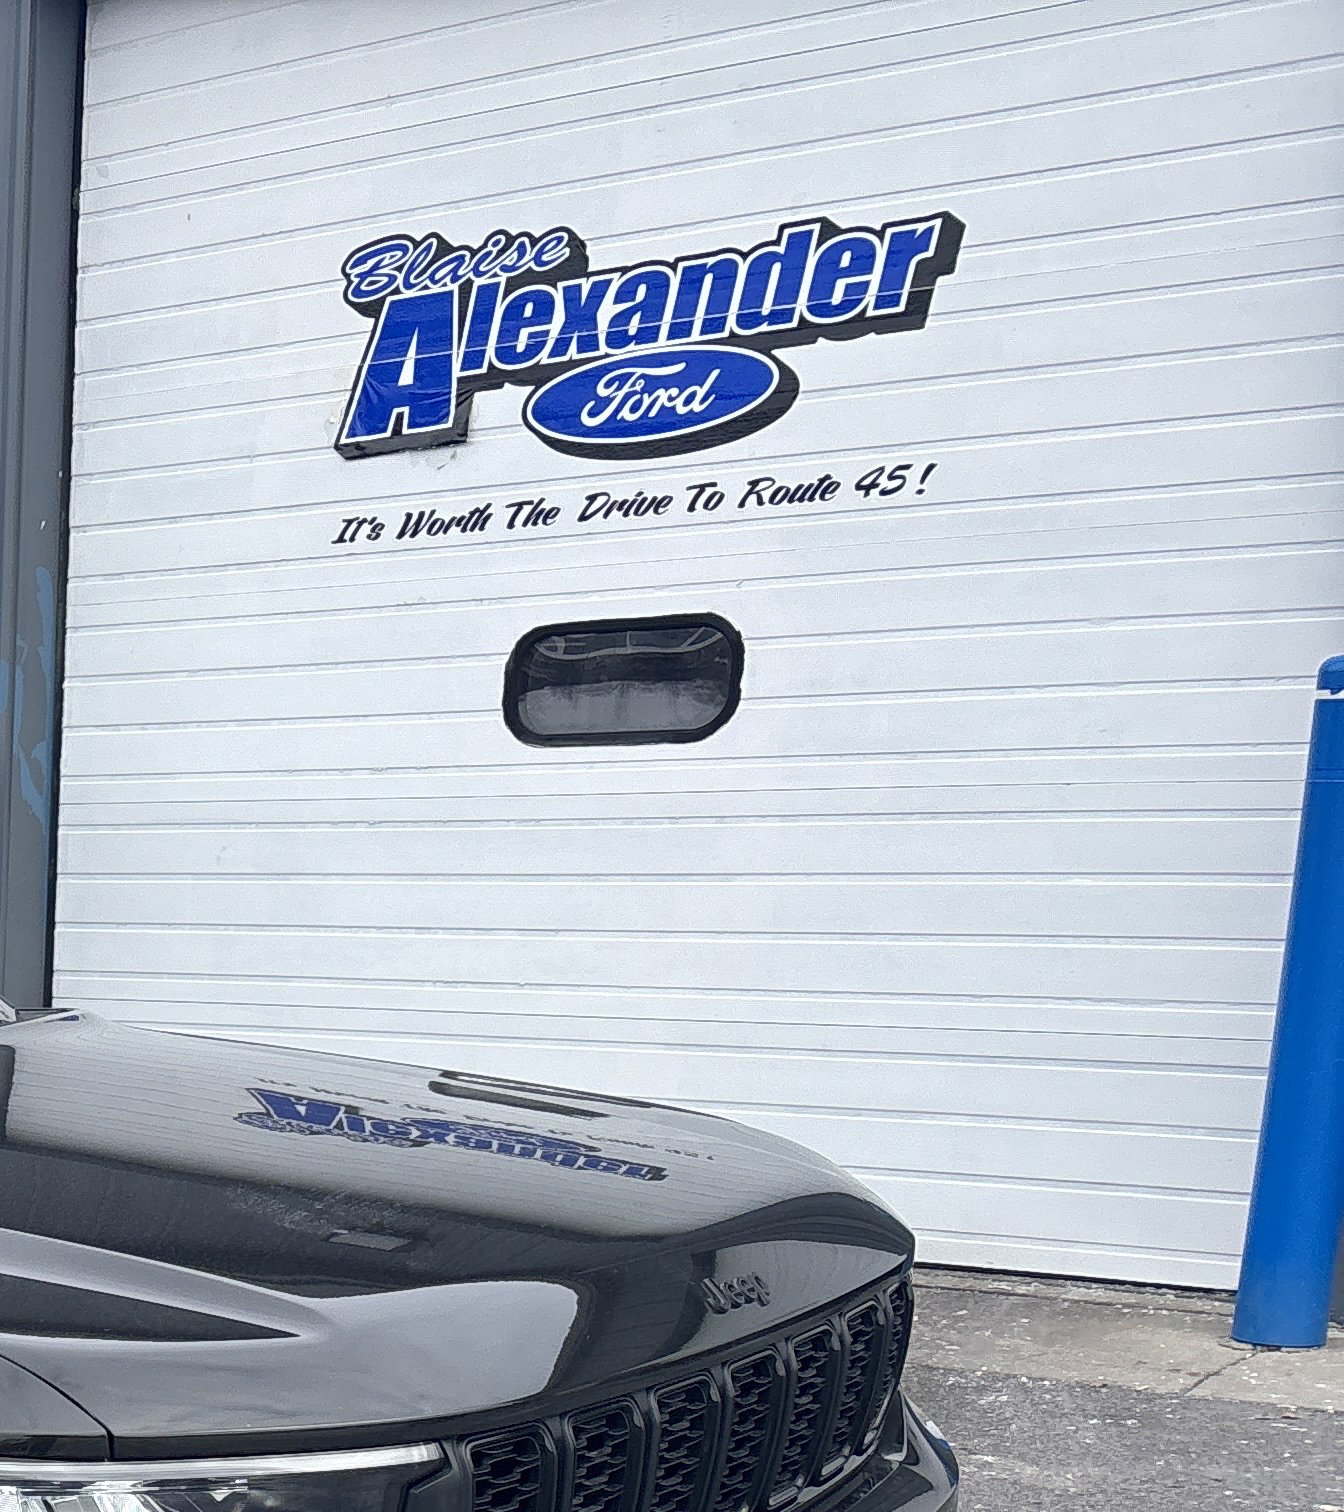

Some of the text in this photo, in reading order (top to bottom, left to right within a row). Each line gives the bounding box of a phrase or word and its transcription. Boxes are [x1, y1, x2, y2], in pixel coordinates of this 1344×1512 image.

[343, 228, 573, 304] Blaise
[336, 214, 952, 448] Alexander
[580, 361, 720, 427] Ford
[331, 516, 386, 545] It's
[395, 502, 493, 540] Worth
[505, 498, 561, 530] The
[576, 490, 674, 523] Drive
[685, 481, 725, 513] To
[737, 474, 841, 509] Route
[700, 1272, 771, 1314] Jeep
